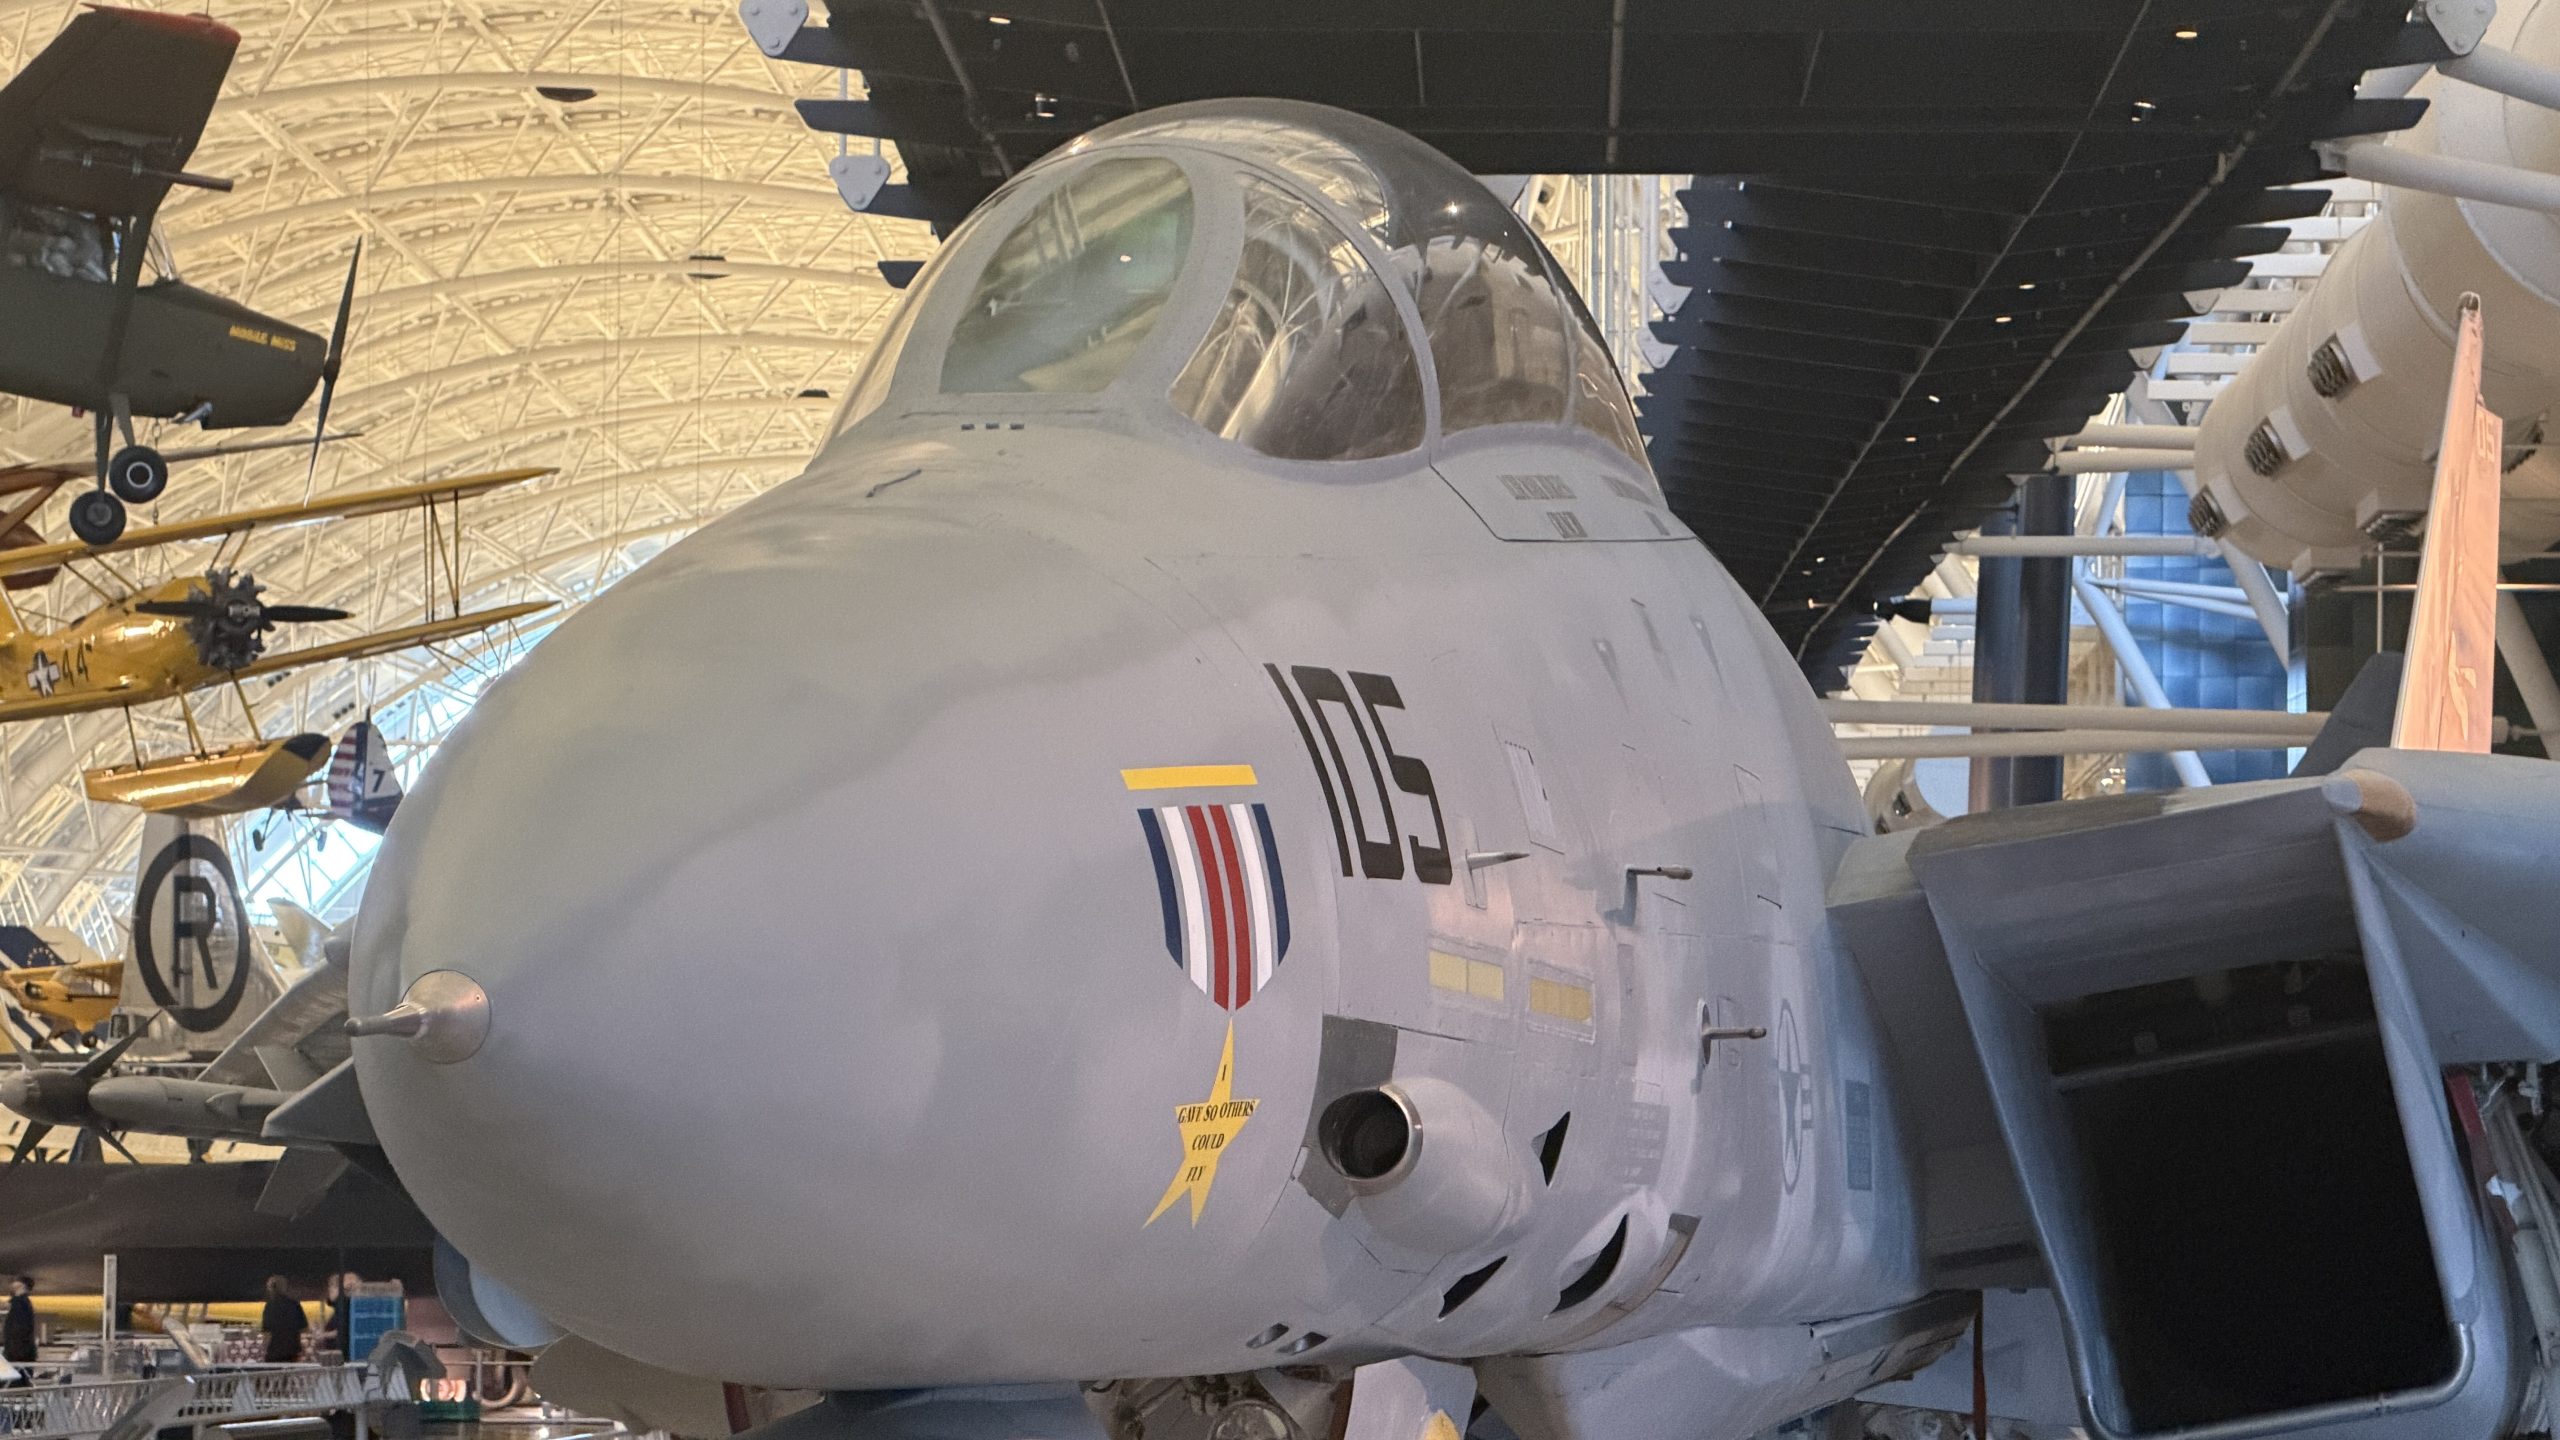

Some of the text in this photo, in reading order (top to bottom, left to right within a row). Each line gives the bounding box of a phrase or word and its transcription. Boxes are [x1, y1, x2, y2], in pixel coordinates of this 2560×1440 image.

[62, 641, 90, 689] 44
[372, 768, 386, 793] 7
[1262, 662, 1453, 886] 105
[173, 876, 219, 989] R
[1221, 1064, 1227, 1081] I
[1203, 1104, 1219, 1122] SO
[1220, 1101, 1255, 1118] OTHERS
[1192, 1133, 1224, 1150] COULD
[1186, 1165, 1206, 1181] FLY
